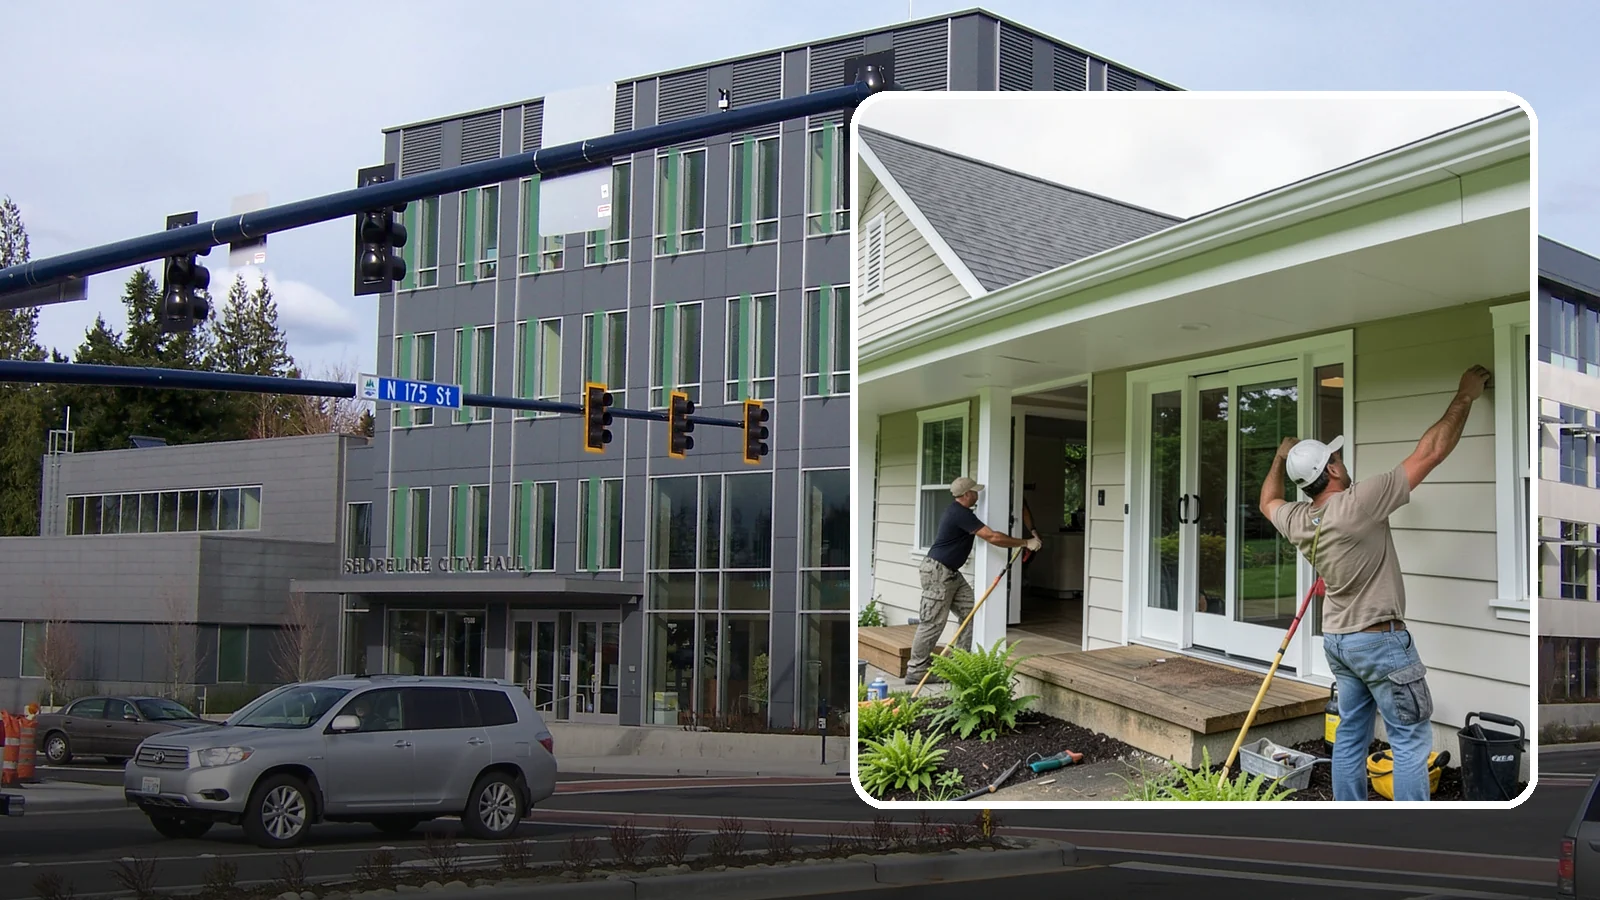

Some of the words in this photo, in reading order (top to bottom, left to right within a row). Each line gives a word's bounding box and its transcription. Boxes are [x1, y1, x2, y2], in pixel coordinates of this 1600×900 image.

[387, 380, 397, 400] N
[405, 383, 428, 403] 175
[436, 386, 452, 406] St
[344, 557, 432, 574] SHORELINE
[438, 556, 476, 572] CITY
[484, 555, 526, 571] HALL
